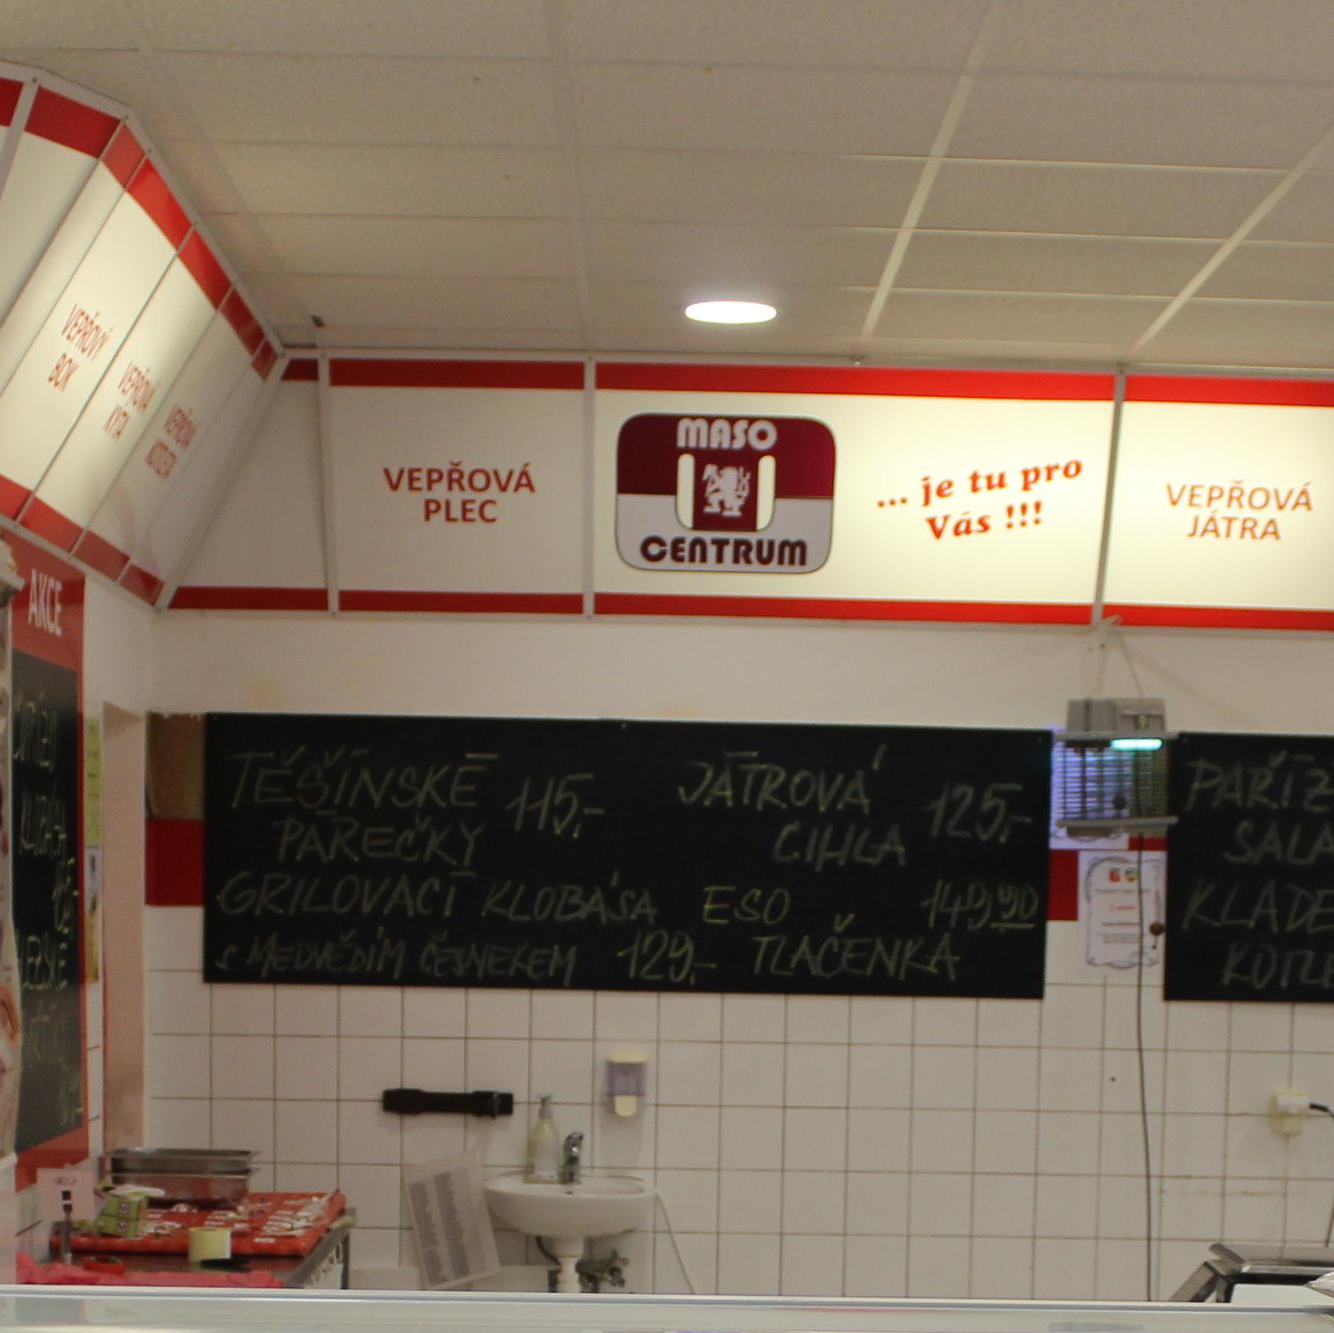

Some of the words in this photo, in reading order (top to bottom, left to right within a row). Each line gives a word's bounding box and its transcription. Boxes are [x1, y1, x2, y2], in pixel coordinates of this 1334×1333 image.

[677, 417, 777, 451] MASO
[383, 459, 536, 494] VEPŘOVÁ
[970, 467, 1008, 494] tu
[1021, 458, 1083, 493] pro
[423, 499, 497, 523] PLEC
[1166, 479, 1314, 513] VEPŘOVÁ
[924, 513, 991, 541] Vás
[1188, 511, 1281, 541] JÁTRA
[639, 535, 807, 567] CENTRUM
[28, 568, 63, 636] AKCE
[227, 745, 499, 809] TĚŠÍNSKÉ
[677, 743, 888, 814] JÁTROVÁ
[272, 811, 482, 866] PÁREČKY
[481, 870, 657, 924] KLOBÁSA
[702, 885, 791, 925] ESO
[753, 912, 961, 981] TLAČENKA
